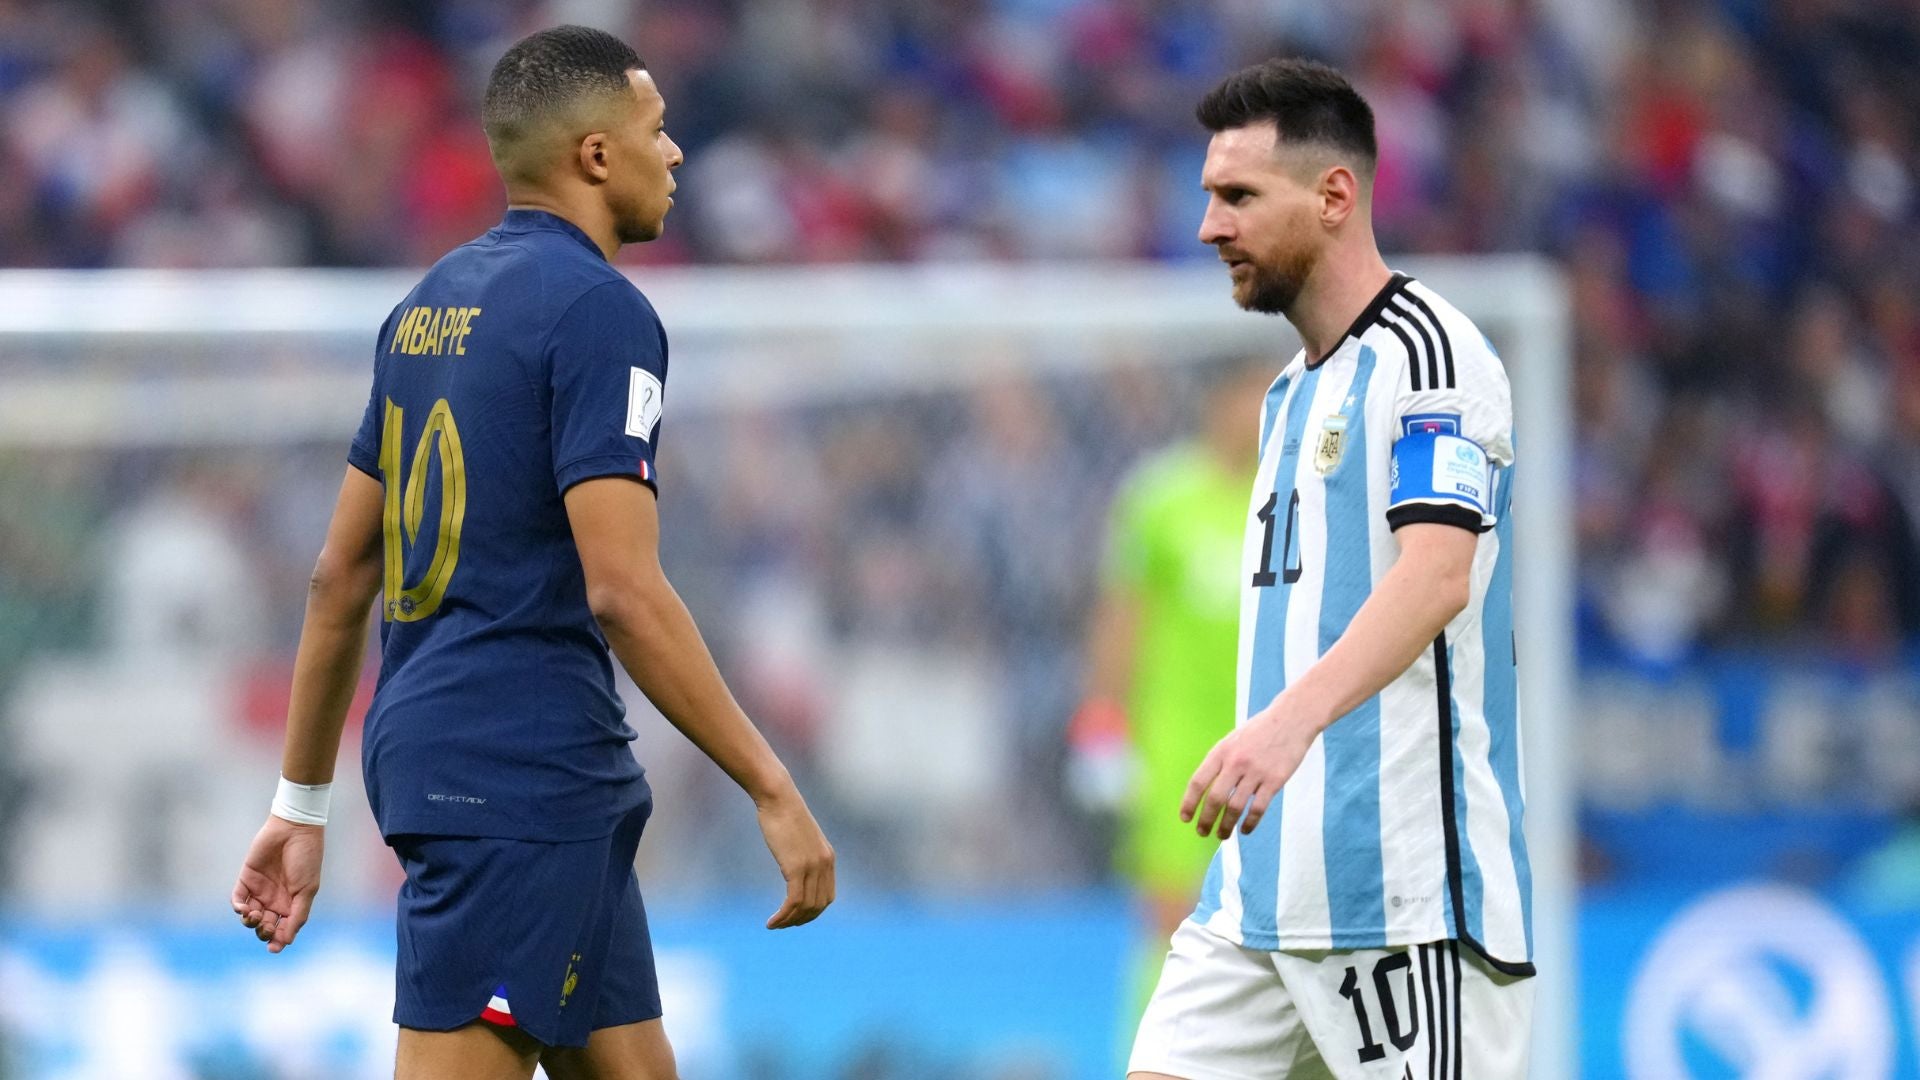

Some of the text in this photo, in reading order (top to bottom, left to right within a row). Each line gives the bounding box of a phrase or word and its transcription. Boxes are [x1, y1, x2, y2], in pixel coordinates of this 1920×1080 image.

[390, 306, 482, 356] MBAPPE
[378, 394, 466, 623] 10
[1252, 488, 1302, 588] 10
[1339, 951, 1419, 1063] 10
